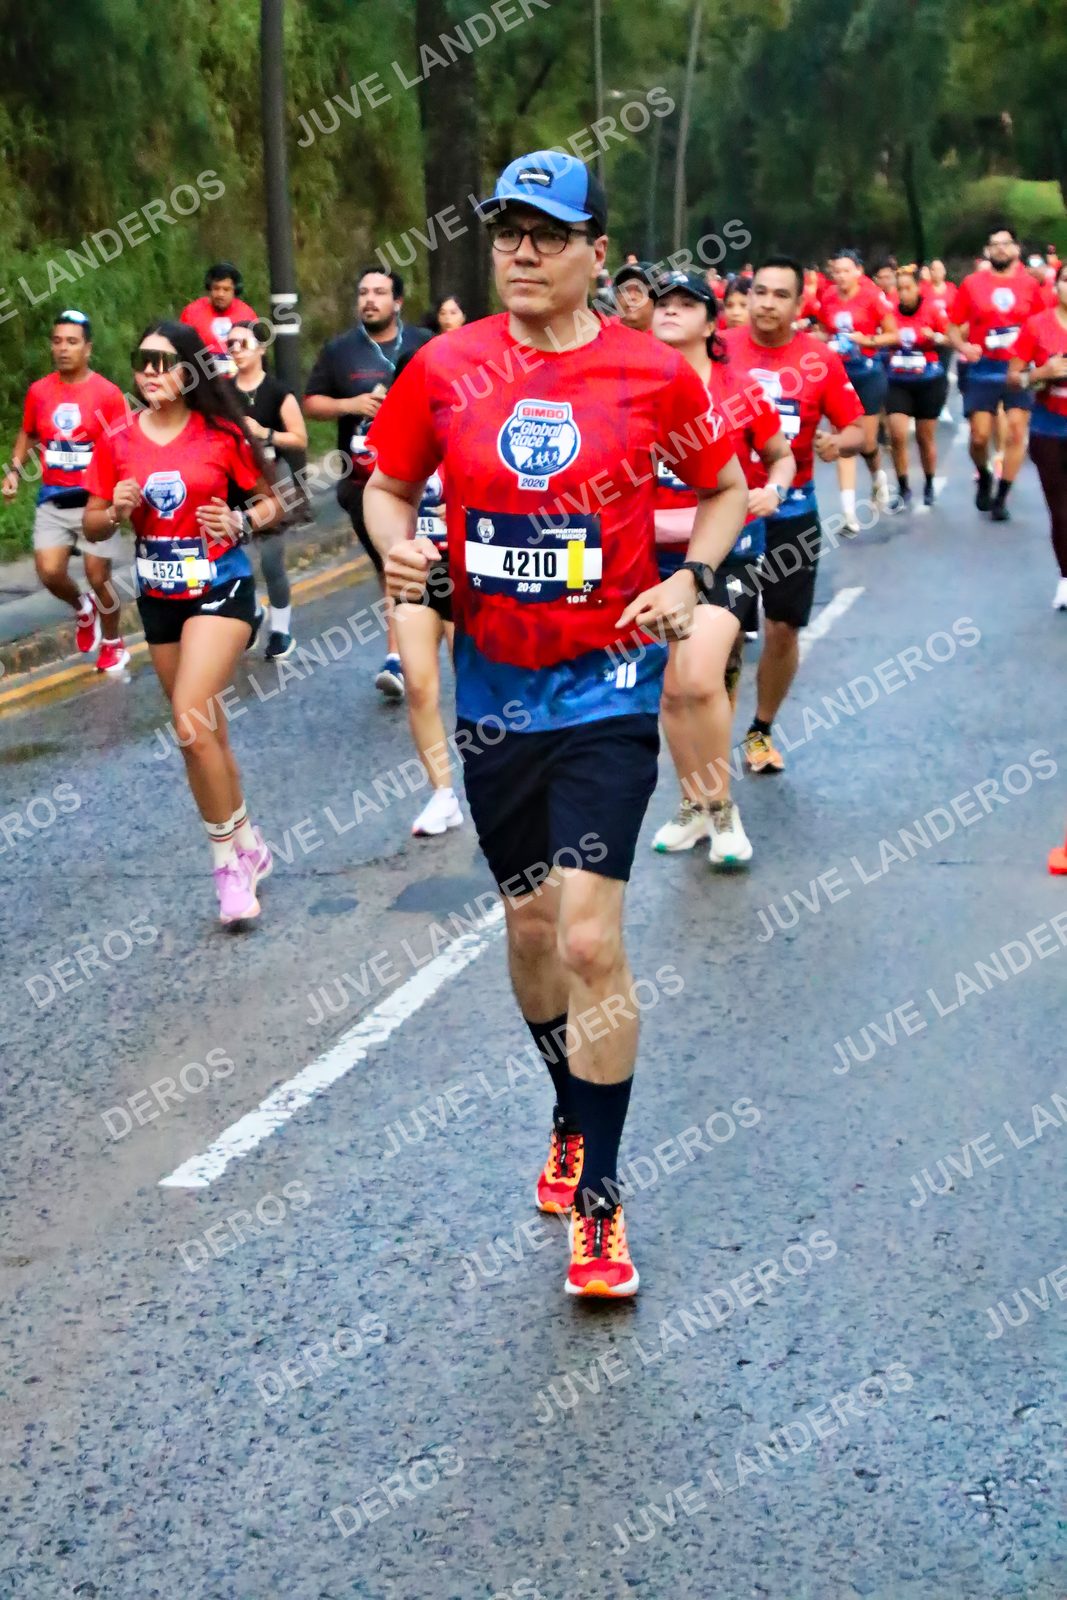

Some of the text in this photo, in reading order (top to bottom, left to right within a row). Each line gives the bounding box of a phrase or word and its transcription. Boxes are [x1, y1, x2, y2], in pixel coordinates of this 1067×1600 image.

[522, 406, 564, 419] BIMBO
[519, 421, 563, 438] Global
[510, 432, 545, 448] Race
[521, 477, 546, 488] 2026
[152, 562, 184, 579] 4524
[503, 549, 557, 578] 4210
[566, 595, 588, 604] 10K
